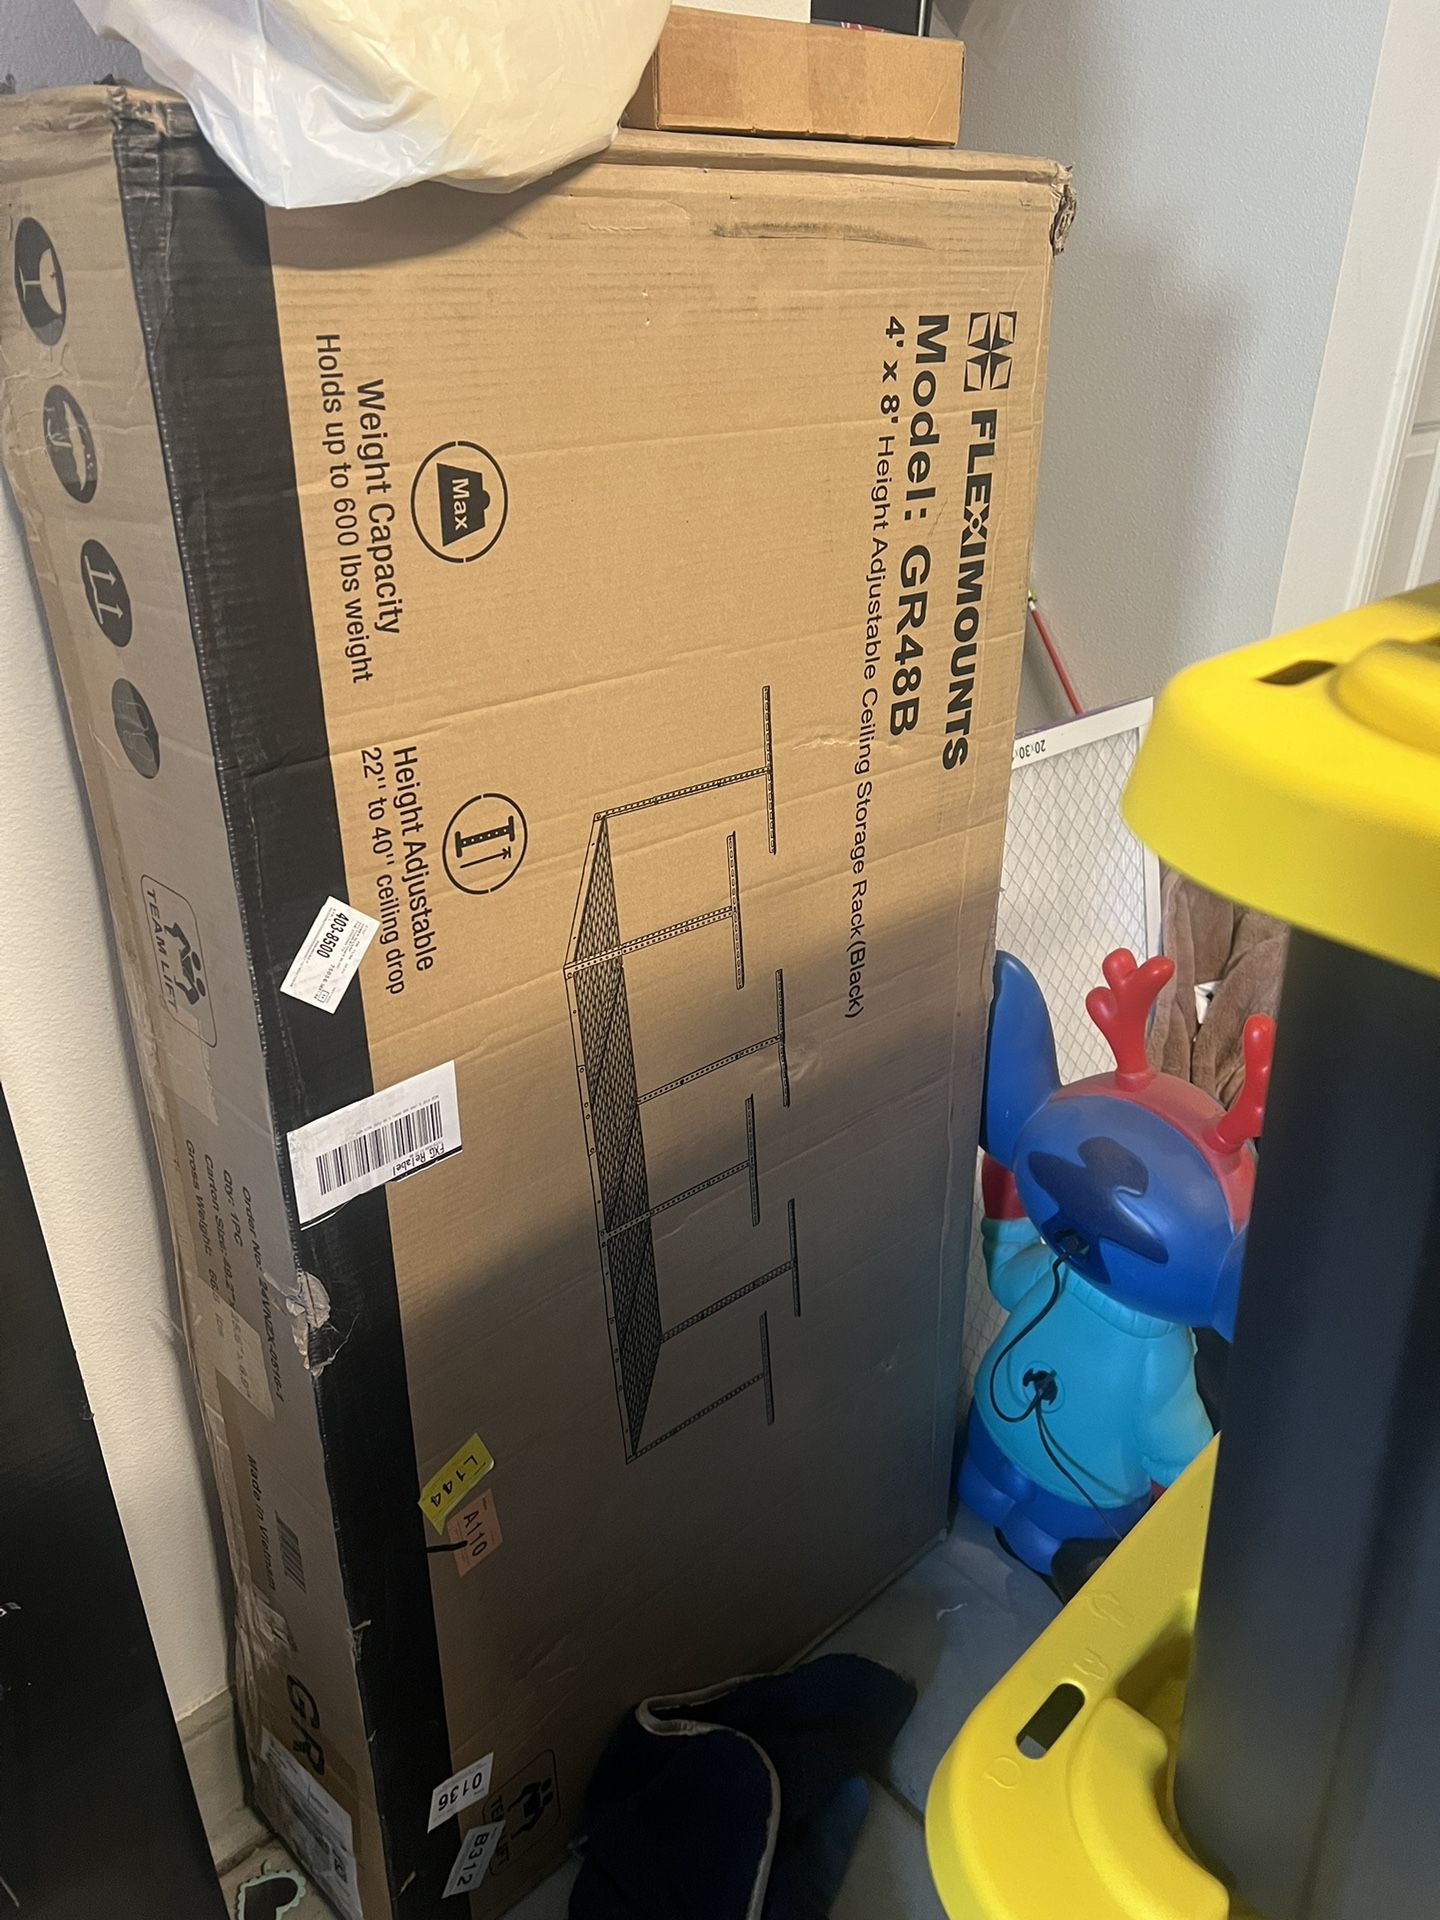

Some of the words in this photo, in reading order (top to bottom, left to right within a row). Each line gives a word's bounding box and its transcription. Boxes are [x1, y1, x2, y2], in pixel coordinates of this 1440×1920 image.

[885, 316, 905, 348] 4'
[315, 334, 346, 414] Holds
[882, 360, 898, 382] x
[356, 378, 392, 495] Weight
[880, 394, 900, 424] 8'
[904, 314, 950, 521] Model:
[321, 422, 347, 456] up
[329, 462, 352, 489] to
[451, 477, 470, 531] Max
[871, 435, 894, 532] Height
[333, 497, 360, 547] 600
[339, 553, 362, 593] lbs
[366, 503, 403, 634] Capacity
[942, 409, 998, 771] FLEXIMOUNTS
[863, 537, 888, 680] Adjustable
[344, 598, 373, 684] weight
[890, 544, 931, 737] GR48B
[854, 687, 878, 775] Ceiling
[367, 797, 388, 821] to
[393, 745, 425, 836] Height
[849, 780, 872, 875] Storage
[376, 874, 401, 945] ceiling
[401, 841, 437, 972] Adjustable
[147, 888, 167, 958] TEAM
[161, 960, 178, 1013] LIFT
[316, 913, 350, 959] 403-8500
[385, 948, 405, 995] drop
[392, 1150, 426, 1177] Relabel
[425, 1142, 445, 1161] FXG
[186, 1139, 200, 1191] Gross
[196, 1194, 212, 1257] Weight:
[204, 1154, 219, 1212] Carton
[224, 1169, 235, 1207] Qty:
[231, 1212, 243, 1247] 1PC
[242, 1186, 257, 1238] Order
[252, 1239, 263, 1272] No:
[247, 1454, 262, 1501] Made
[430, 1455, 478, 1507] L144
[256, 1503, 264, 1521] in
[464, 1510, 487, 1556] A110
[259, 1525, 276, 1591] Vietnam
[438, 1772, 483, 1812] 0136
[457, 1831, 490, 1887] B312
